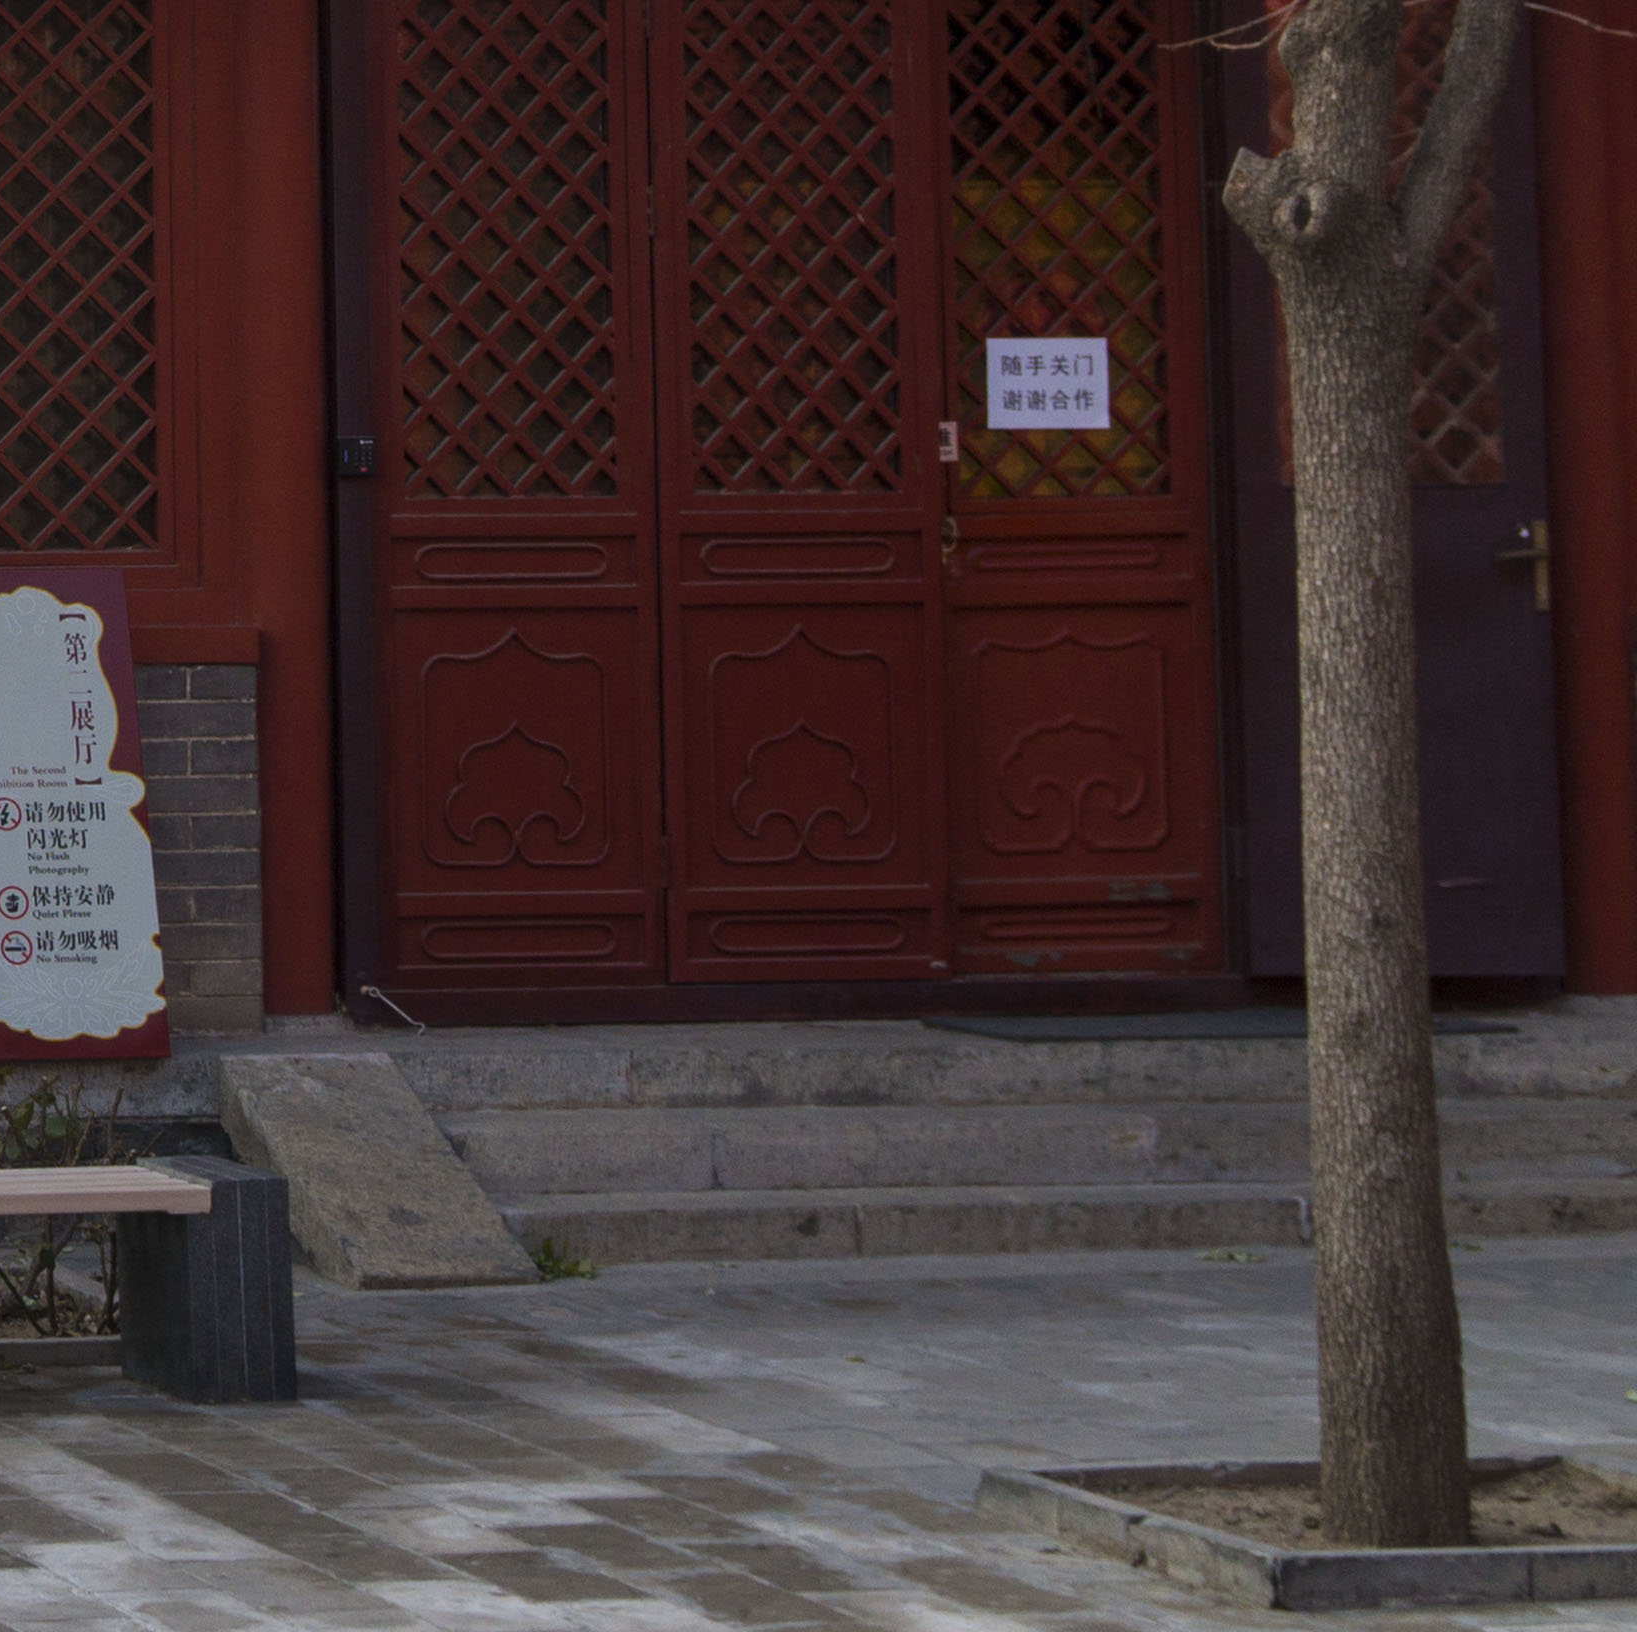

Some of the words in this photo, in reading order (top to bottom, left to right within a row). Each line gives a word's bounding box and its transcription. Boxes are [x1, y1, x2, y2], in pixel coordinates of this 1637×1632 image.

[1001, 354, 1094, 376] 随手关门
[1002, 388, 1094, 411] 谢谢合作
[9, 766, 29, 775] The
[31, 765, 66, 775] Second
[37, 779, 68, 788] Room
[25, 801, 106, 823] 请勿使用
[27, 828, 88, 849] 闪光灯
[28, 852, 42, 861] No
[46, 852, 70, 861] Flash
[28, 865, 89, 876] Photography
[32, 884, 115, 907] 保持安静
[32, 909, 59, 920] Quiet
[63, 909, 92, 918] Please
[36, 929, 118, 952] 请勿吸烟
[36, 954, 51, 963] No
[54, 954, 98, 965] Smoking
